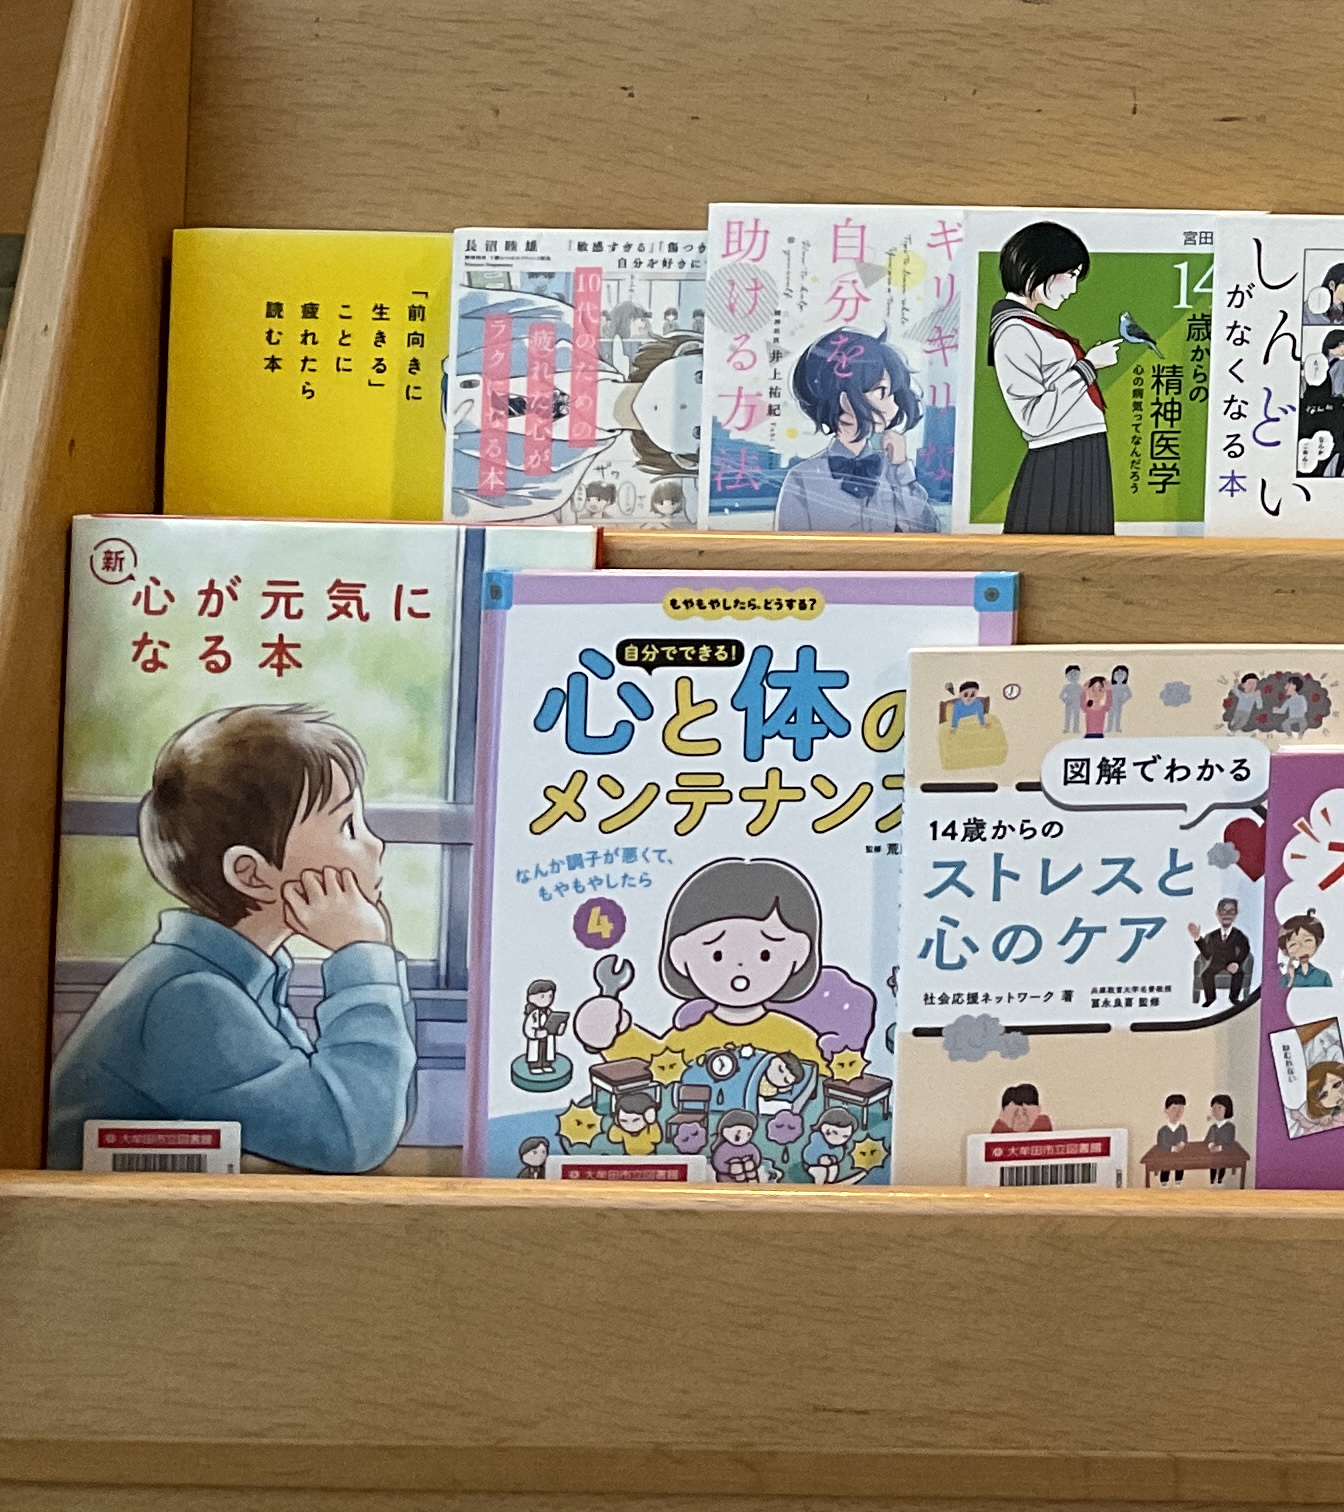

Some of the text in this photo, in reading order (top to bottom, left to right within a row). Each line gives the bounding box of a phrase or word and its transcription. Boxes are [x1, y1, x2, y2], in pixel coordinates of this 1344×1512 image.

[263, 300, 284, 374] 読む本
[335, 303, 354, 374] ことに
[824, 222, 871, 378] 自分を
[299, 301, 320, 401] 疲れたら
[367, 302, 390, 389] 生きる」
[405, 289, 429, 401] 「前向きに
[570, 273, 600, 441] 10代のための
[714, 217, 770, 493] 助ける方法
[766, 350, 783, 417] 井上祐紀
[918, 218, 964, 483] ギリギリな
[1252, 237, 1311, 517] しんどい
[481, 320, 509, 491] ラクになる本
[527, 328, 555, 471] 疲れた心が
[1129, 363, 1145, 495] 心の病気ってなんだろう
[1148, 363, 1185, 494] 精神医学
[1218, 282, 1255, 498] がなくなる本
[100, 548, 126, 573] 新
[132, 575, 432, 622] 心が元気に
[132, 633, 303, 677] なる本
[624, 643, 737, 662] 自分でできる!
[533, 645, 908, 763] 心と体の
[1062, 755, 1252, 786] 図解でわかる
[929, 817, 1064, 843] 14歳からの
[538, 871, 652, 902] もやもやしたら
[923, 846, 1195, 902] ストレスと
[586, 907, 614, 939] 4
[917, 915, 1168, 971] 心のケア
[923, 989, 1055, 1005] 社会応援ネットワーク
